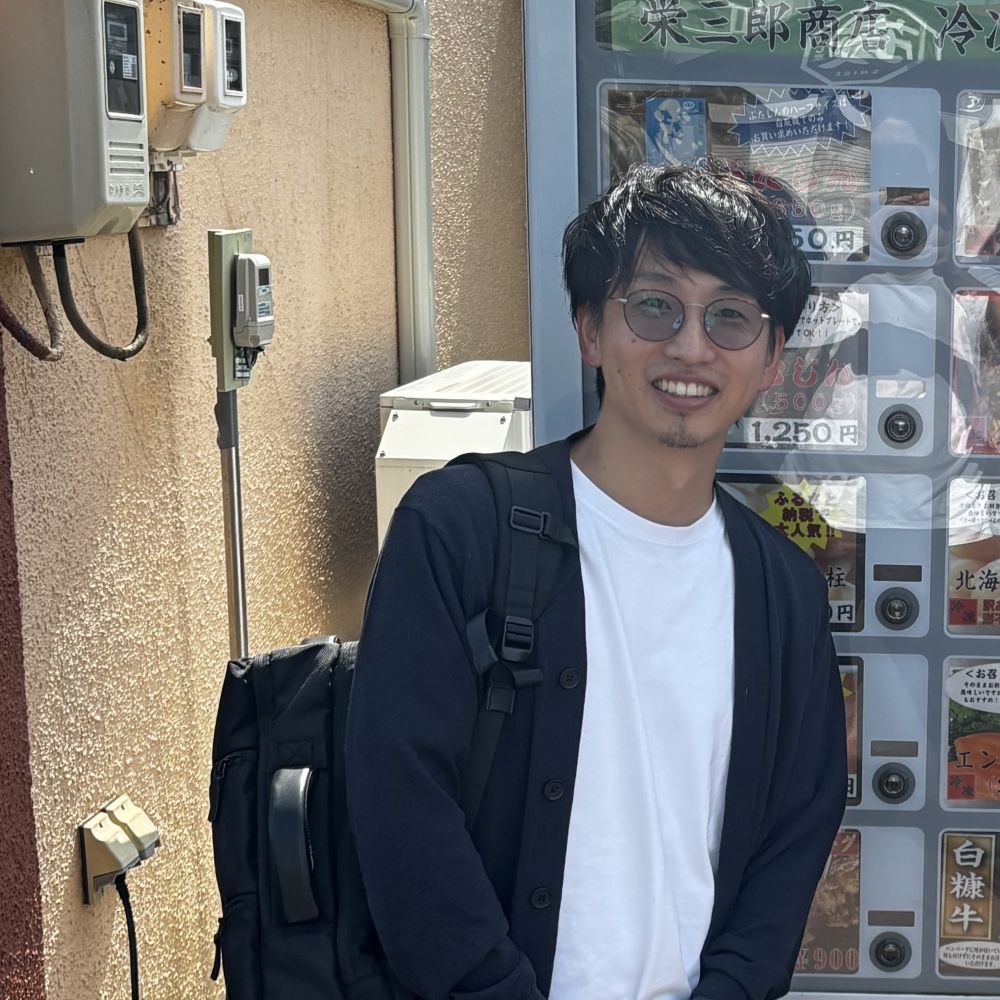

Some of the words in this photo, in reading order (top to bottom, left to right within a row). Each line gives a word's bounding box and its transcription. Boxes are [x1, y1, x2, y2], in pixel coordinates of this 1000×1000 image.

[640, 0, 891, 50] 栄三郎商店
[792, 227, 855, 250] 50円
[826, 567, 846, 588] 柱
[949, 839, 985, 932] 白糠牛
